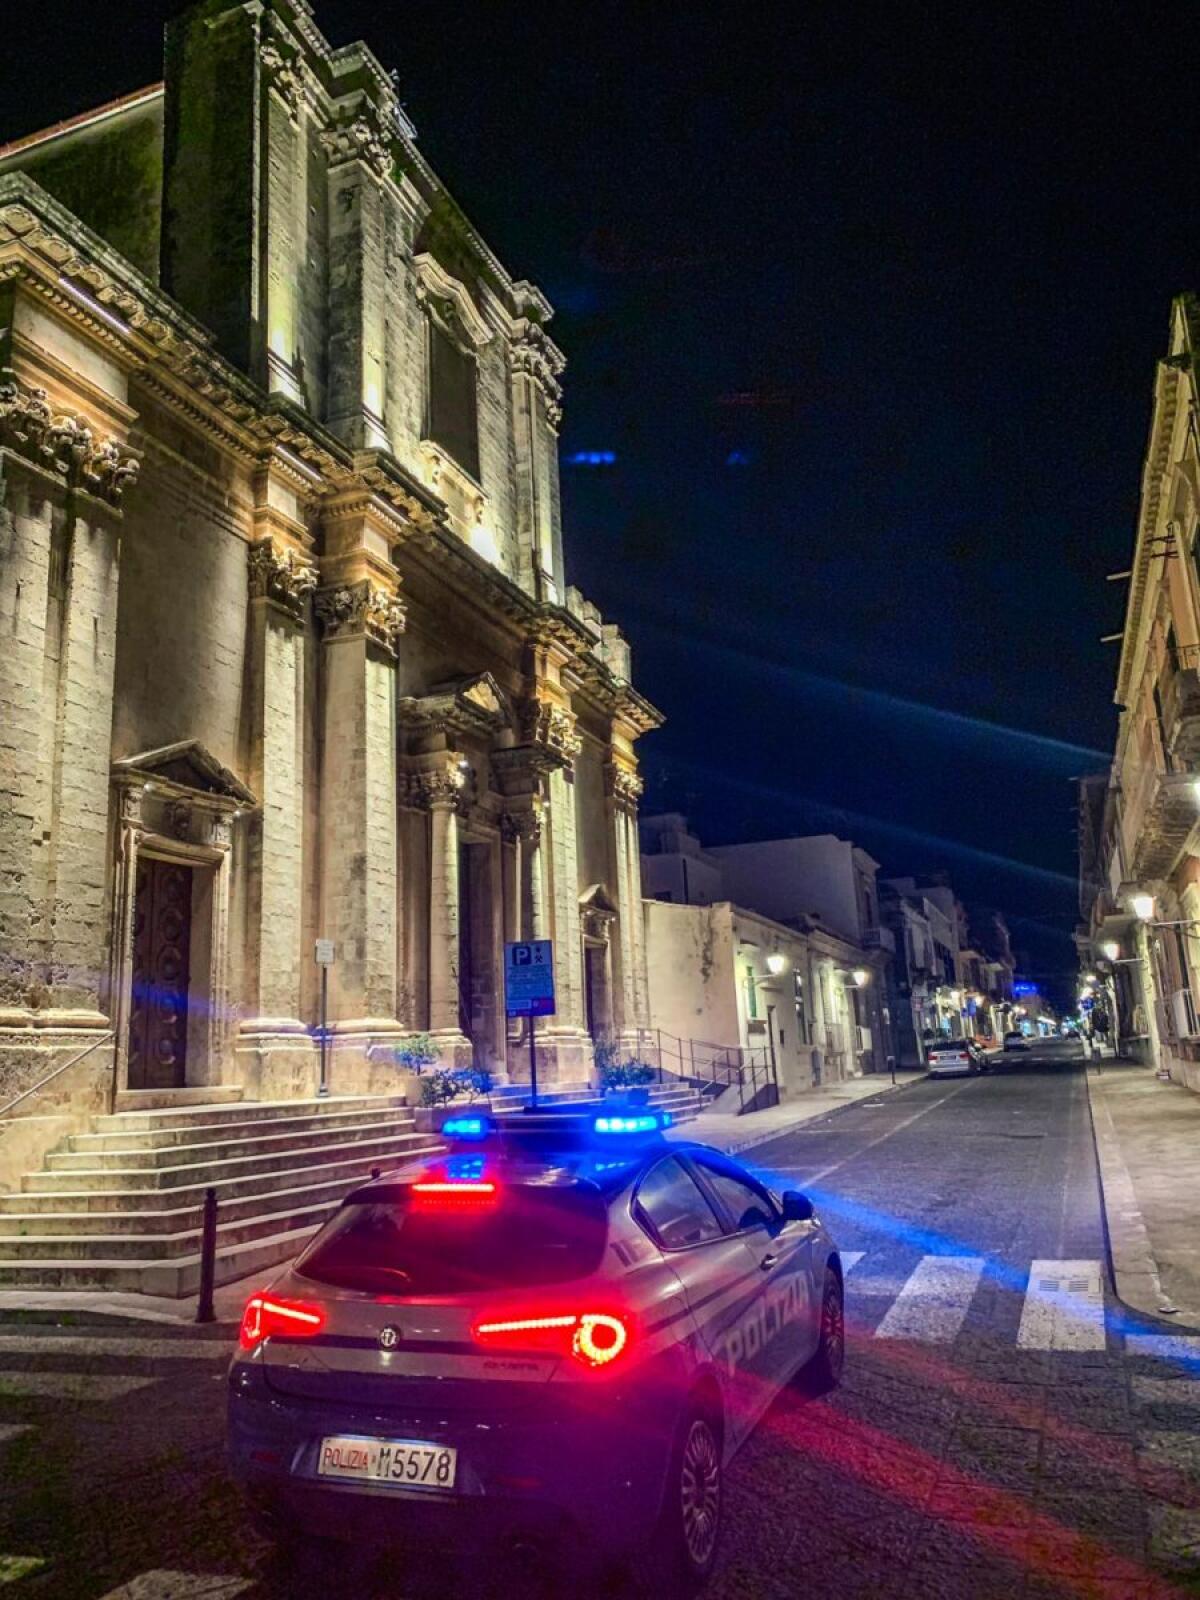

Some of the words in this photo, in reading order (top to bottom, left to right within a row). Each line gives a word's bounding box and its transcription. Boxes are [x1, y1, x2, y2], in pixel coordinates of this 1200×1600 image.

[515, 948, 529, 965] P
[724, 1268, 810, 1378] POLIZIA
[323, 1446, 369, 1470] POLIZIA
[376, 1447, 451, 1482] M5578
